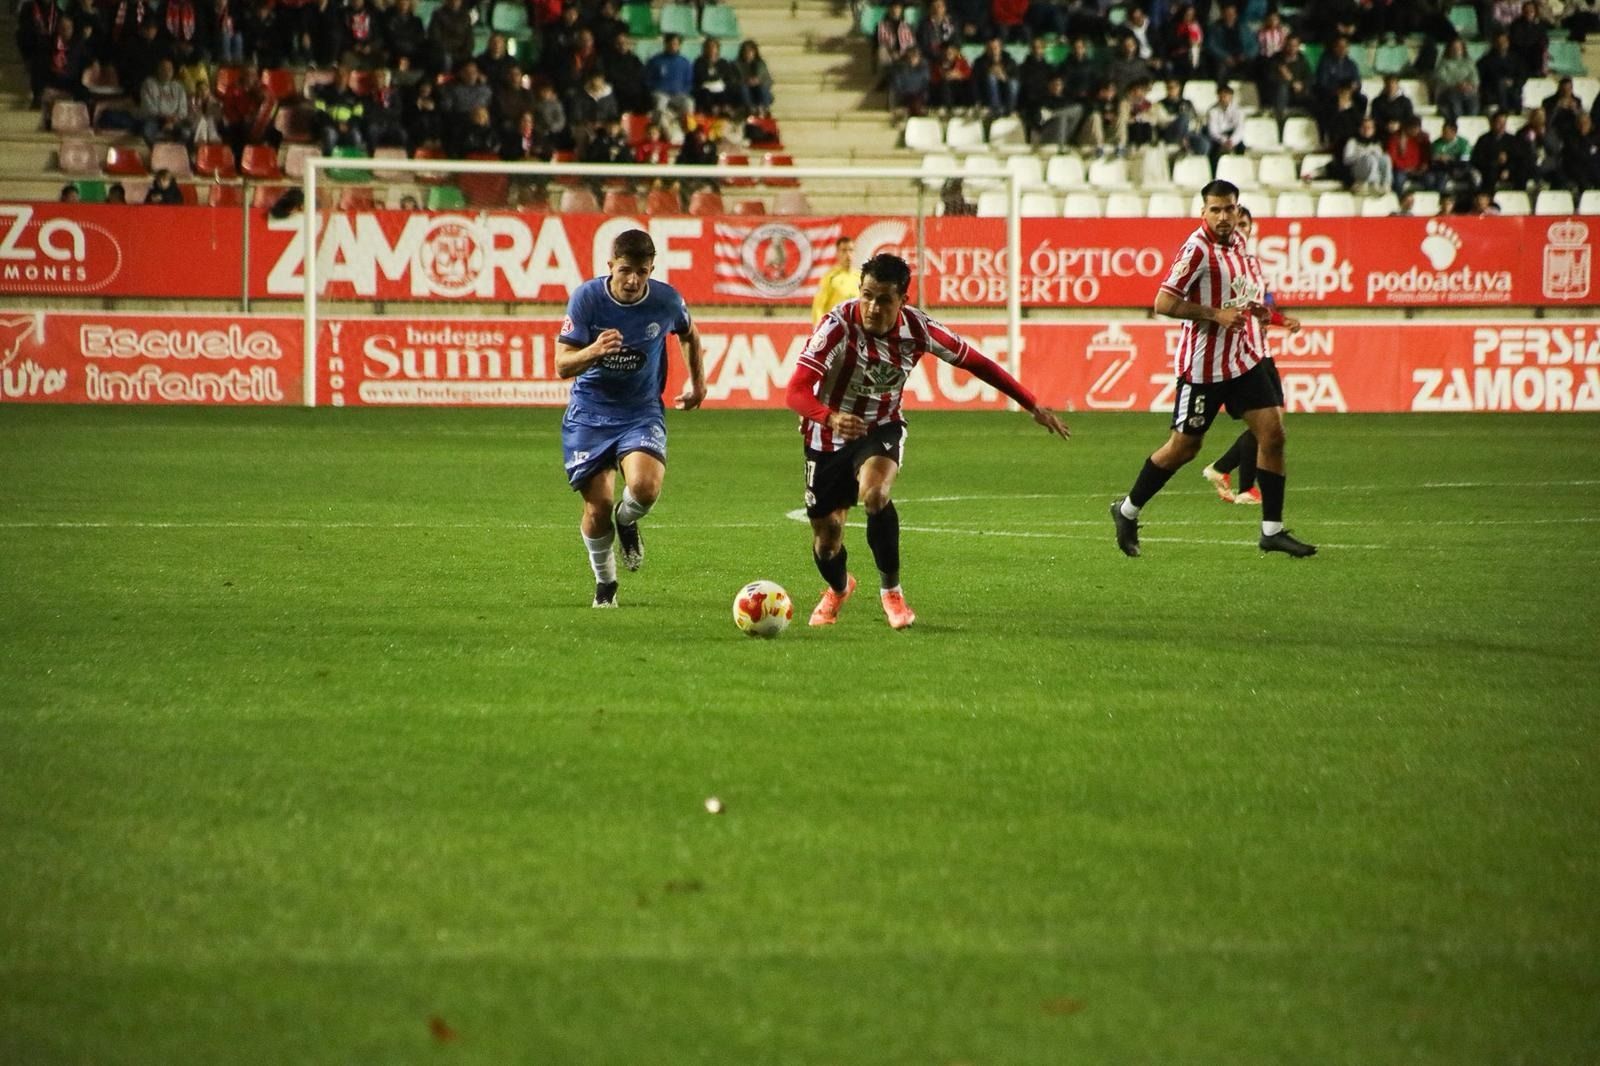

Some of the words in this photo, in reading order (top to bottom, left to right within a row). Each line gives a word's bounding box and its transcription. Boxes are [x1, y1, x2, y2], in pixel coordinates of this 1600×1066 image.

[266, 212, 585, 298] ZAMORA
[1029, 238, 1164, 277] ÓPTICO
[940, 273, 1100, 303] ROBERTO
[1367, 264, 1512, 303] podoactiva
[80, 323, 283, 359] Escuela
[406, 326, 504, 348] bodegas
[84, 363, 284, 401] infantil
